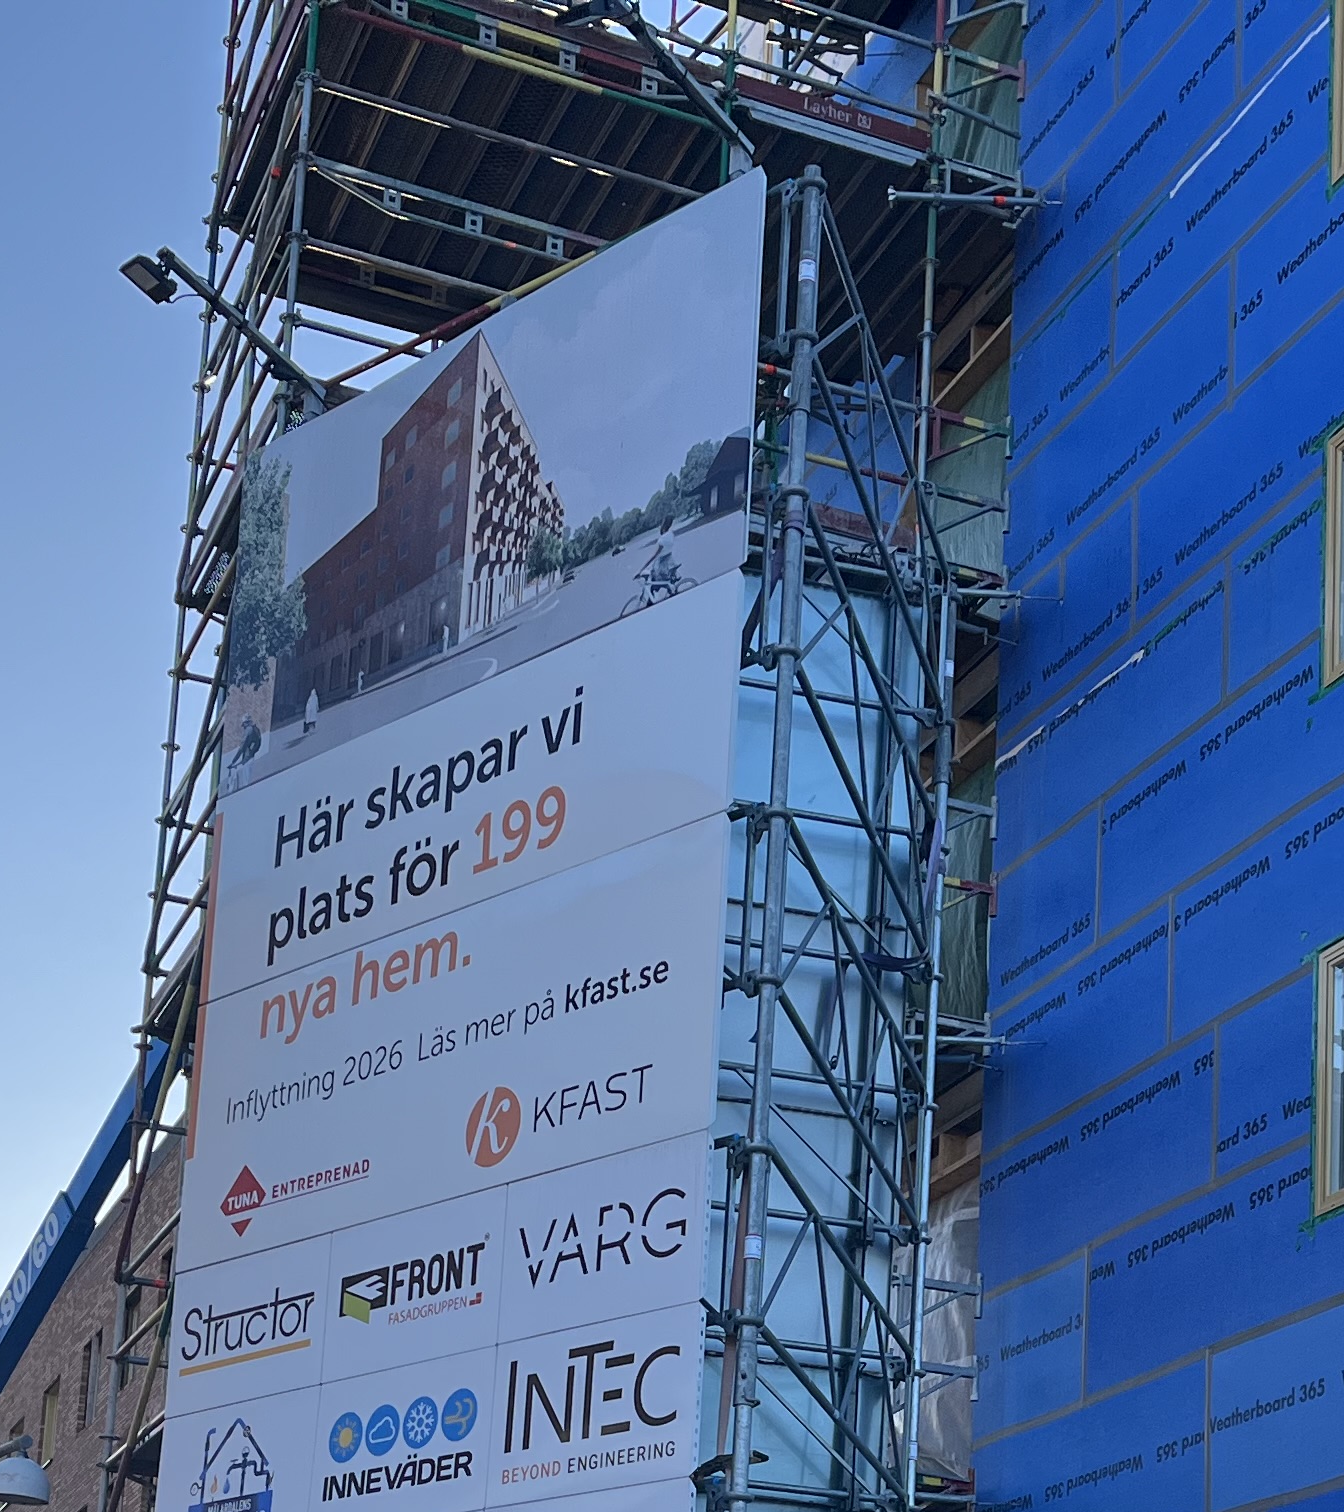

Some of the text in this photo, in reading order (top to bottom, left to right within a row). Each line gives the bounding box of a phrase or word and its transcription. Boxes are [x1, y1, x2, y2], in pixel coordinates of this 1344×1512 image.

[803, 97, 852, 123] Layher
[1078, 66, 1095, 96] 365
[1178, 71, 1200, 104] 365
[1094, 109, 1168, 204] Weatherboard
[1186, 109, 1294, 232] Weatherboard 365
[1153, 237, 1175, 271] 365
[1239, 289, 1264, 323] 365
[1066, 427, 1161, 526] Weatherboard 365
[1174, 461, 1284, 566] Weatherboard 365
[1143, 566, 1164, 596] 365
[1041, 614, 1113, 683] Weatherboard
[1199, 664, 1314, 762] Weatherboard 365
[275, 686, 586, 863] Här skapar vi
[1109, 759, 1187, 831] Weatherboard
[266, 785, 568, 966] plats för 199
[1284, 829, 1310, 860] 365
[1184, 855, 1271, 925] Weatherboard
[999, 913, 1091, 987] Weatherboard 365
[1077, 967, 1097, 997] 365
[259, 931, 472, 1045] nya hem.
[226, 956, 671, 1126] Inflyttning 2026 Läs mer på kfast.se
[532, 1063, 655, 1133] KFAST
[1080, 1069, 1181, 1142] Weatherboard 365
[1243, 1113, 1268, 1140] 365
[227, 1158, 371, 1212] TUNA ENTREPRENAD
[998, 1135, 1070, 1189] Weatherboard
[1250, 1183, 1274, 1210] 365
[518, 1187, 688, 1288] VARG
[1128, 1201, 1236, 1269] Weatherboard 365
[388, 1242, 486, 1306] FRONT
[181, 1287, 316, 1363] Structor
[387, 1295, 468, 1326] FASADGRUPPEN
[1000, 1317, 1073, 1362] Weatherboard
[504, 1338, 681, 1454] INTEC
[1298, 1378, 1326, 1406] 365
[322, 1450, 473, 1502] INNEVÄDER
[501, 1441, 676, 1486] BEYOND ENGINEERING
[1045, 1454, 1143, 1502] Weatherboard 365
[1156, 1441, 1179, 1463] 365
